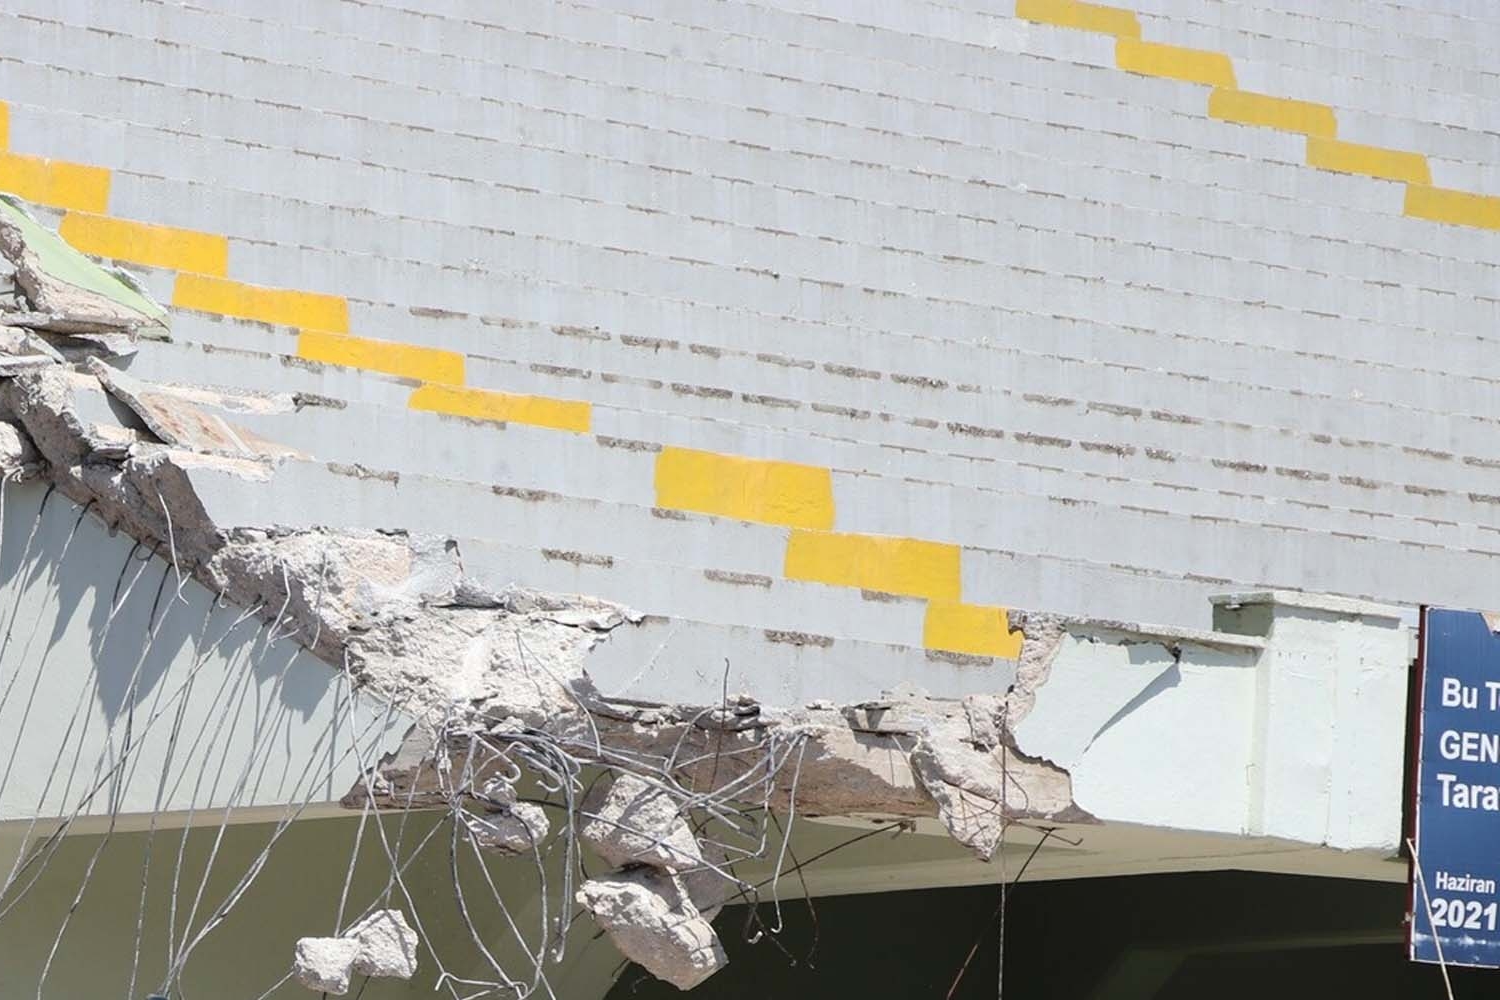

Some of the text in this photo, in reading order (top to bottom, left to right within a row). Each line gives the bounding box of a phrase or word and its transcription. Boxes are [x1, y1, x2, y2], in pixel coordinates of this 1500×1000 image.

[1442, 677, 1500, 711] Bu T
[1436, 773, 1500, 811] Tara
[1435, 871, 1496, 894] Haziran
[1431, 898, 1497, 931] 2021
